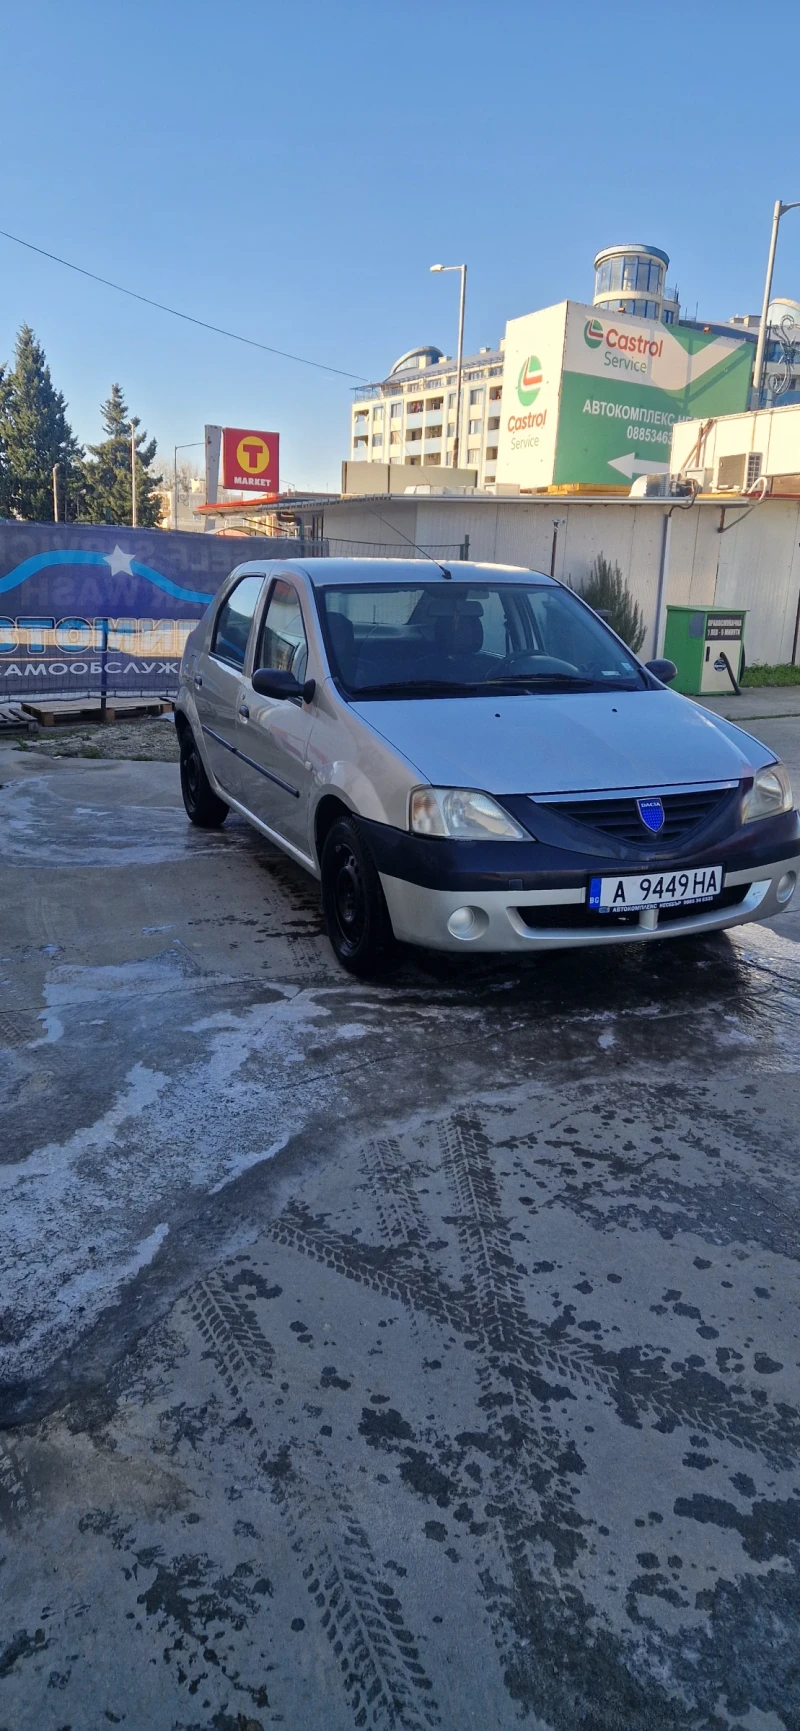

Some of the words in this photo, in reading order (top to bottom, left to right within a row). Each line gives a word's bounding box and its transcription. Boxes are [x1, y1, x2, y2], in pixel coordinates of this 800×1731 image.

[606, 328, 663, 357] Castrol
[604, 351, 647, 373] Service
[507, 409, 547, 432] Castrol
[583, 399, 675, 426] АВТОКОМПЛЕКС
[511, 435, 540, 450] Service
[243, 443, 263, 468] T
[233, 476, 271, 487] MARKET
[0, 662, 179, 676] АМООБСЛУЖ
[640, 873, 690, 901] 9449
[589, 896, 600, 904] BG
[612, 904, 657, 912] АВТОКОМПЛЕКС
